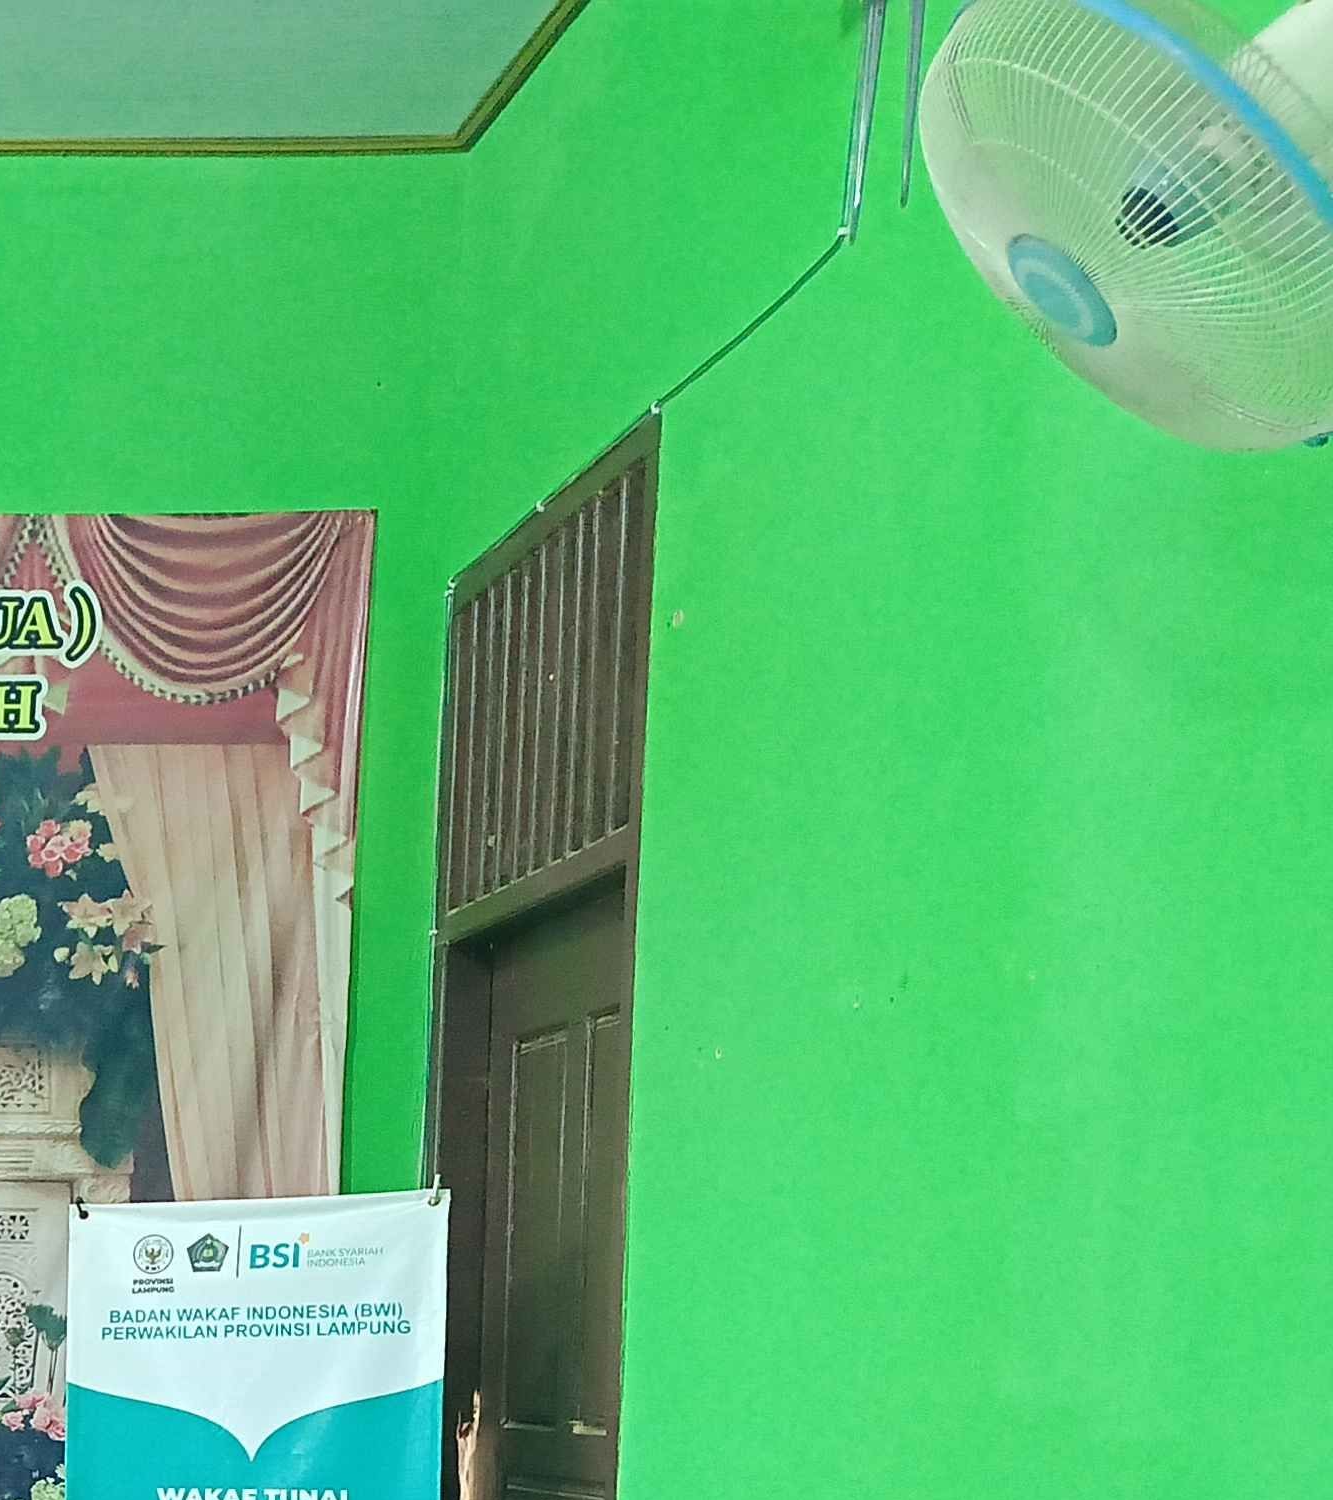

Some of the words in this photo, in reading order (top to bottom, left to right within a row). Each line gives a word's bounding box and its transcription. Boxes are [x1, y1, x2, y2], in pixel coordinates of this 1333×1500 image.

[249, 1242, 300, 1269] BSI
[307, 1247, 336, 1258] BANK
[307, 1256, 366, 1268] INDONESIA
[133, 1278, 174, 1286] PROVINSI
[132, 1286, 175, 1294] LAMPUNG
[109, 1309, 171, 1324] BADAN
[177, 1307, 241, 1322] WAKAF
[247, 1304, 349, 1320] INDONESIA
[354, 1302, 403, 1321] (BWI)
[101, 1325, 218, 1340] PERWAKILAN
[224, 1322, 310, 1338] PROVINSI
[316, 1320, 411, 1336] LAMPUNG
